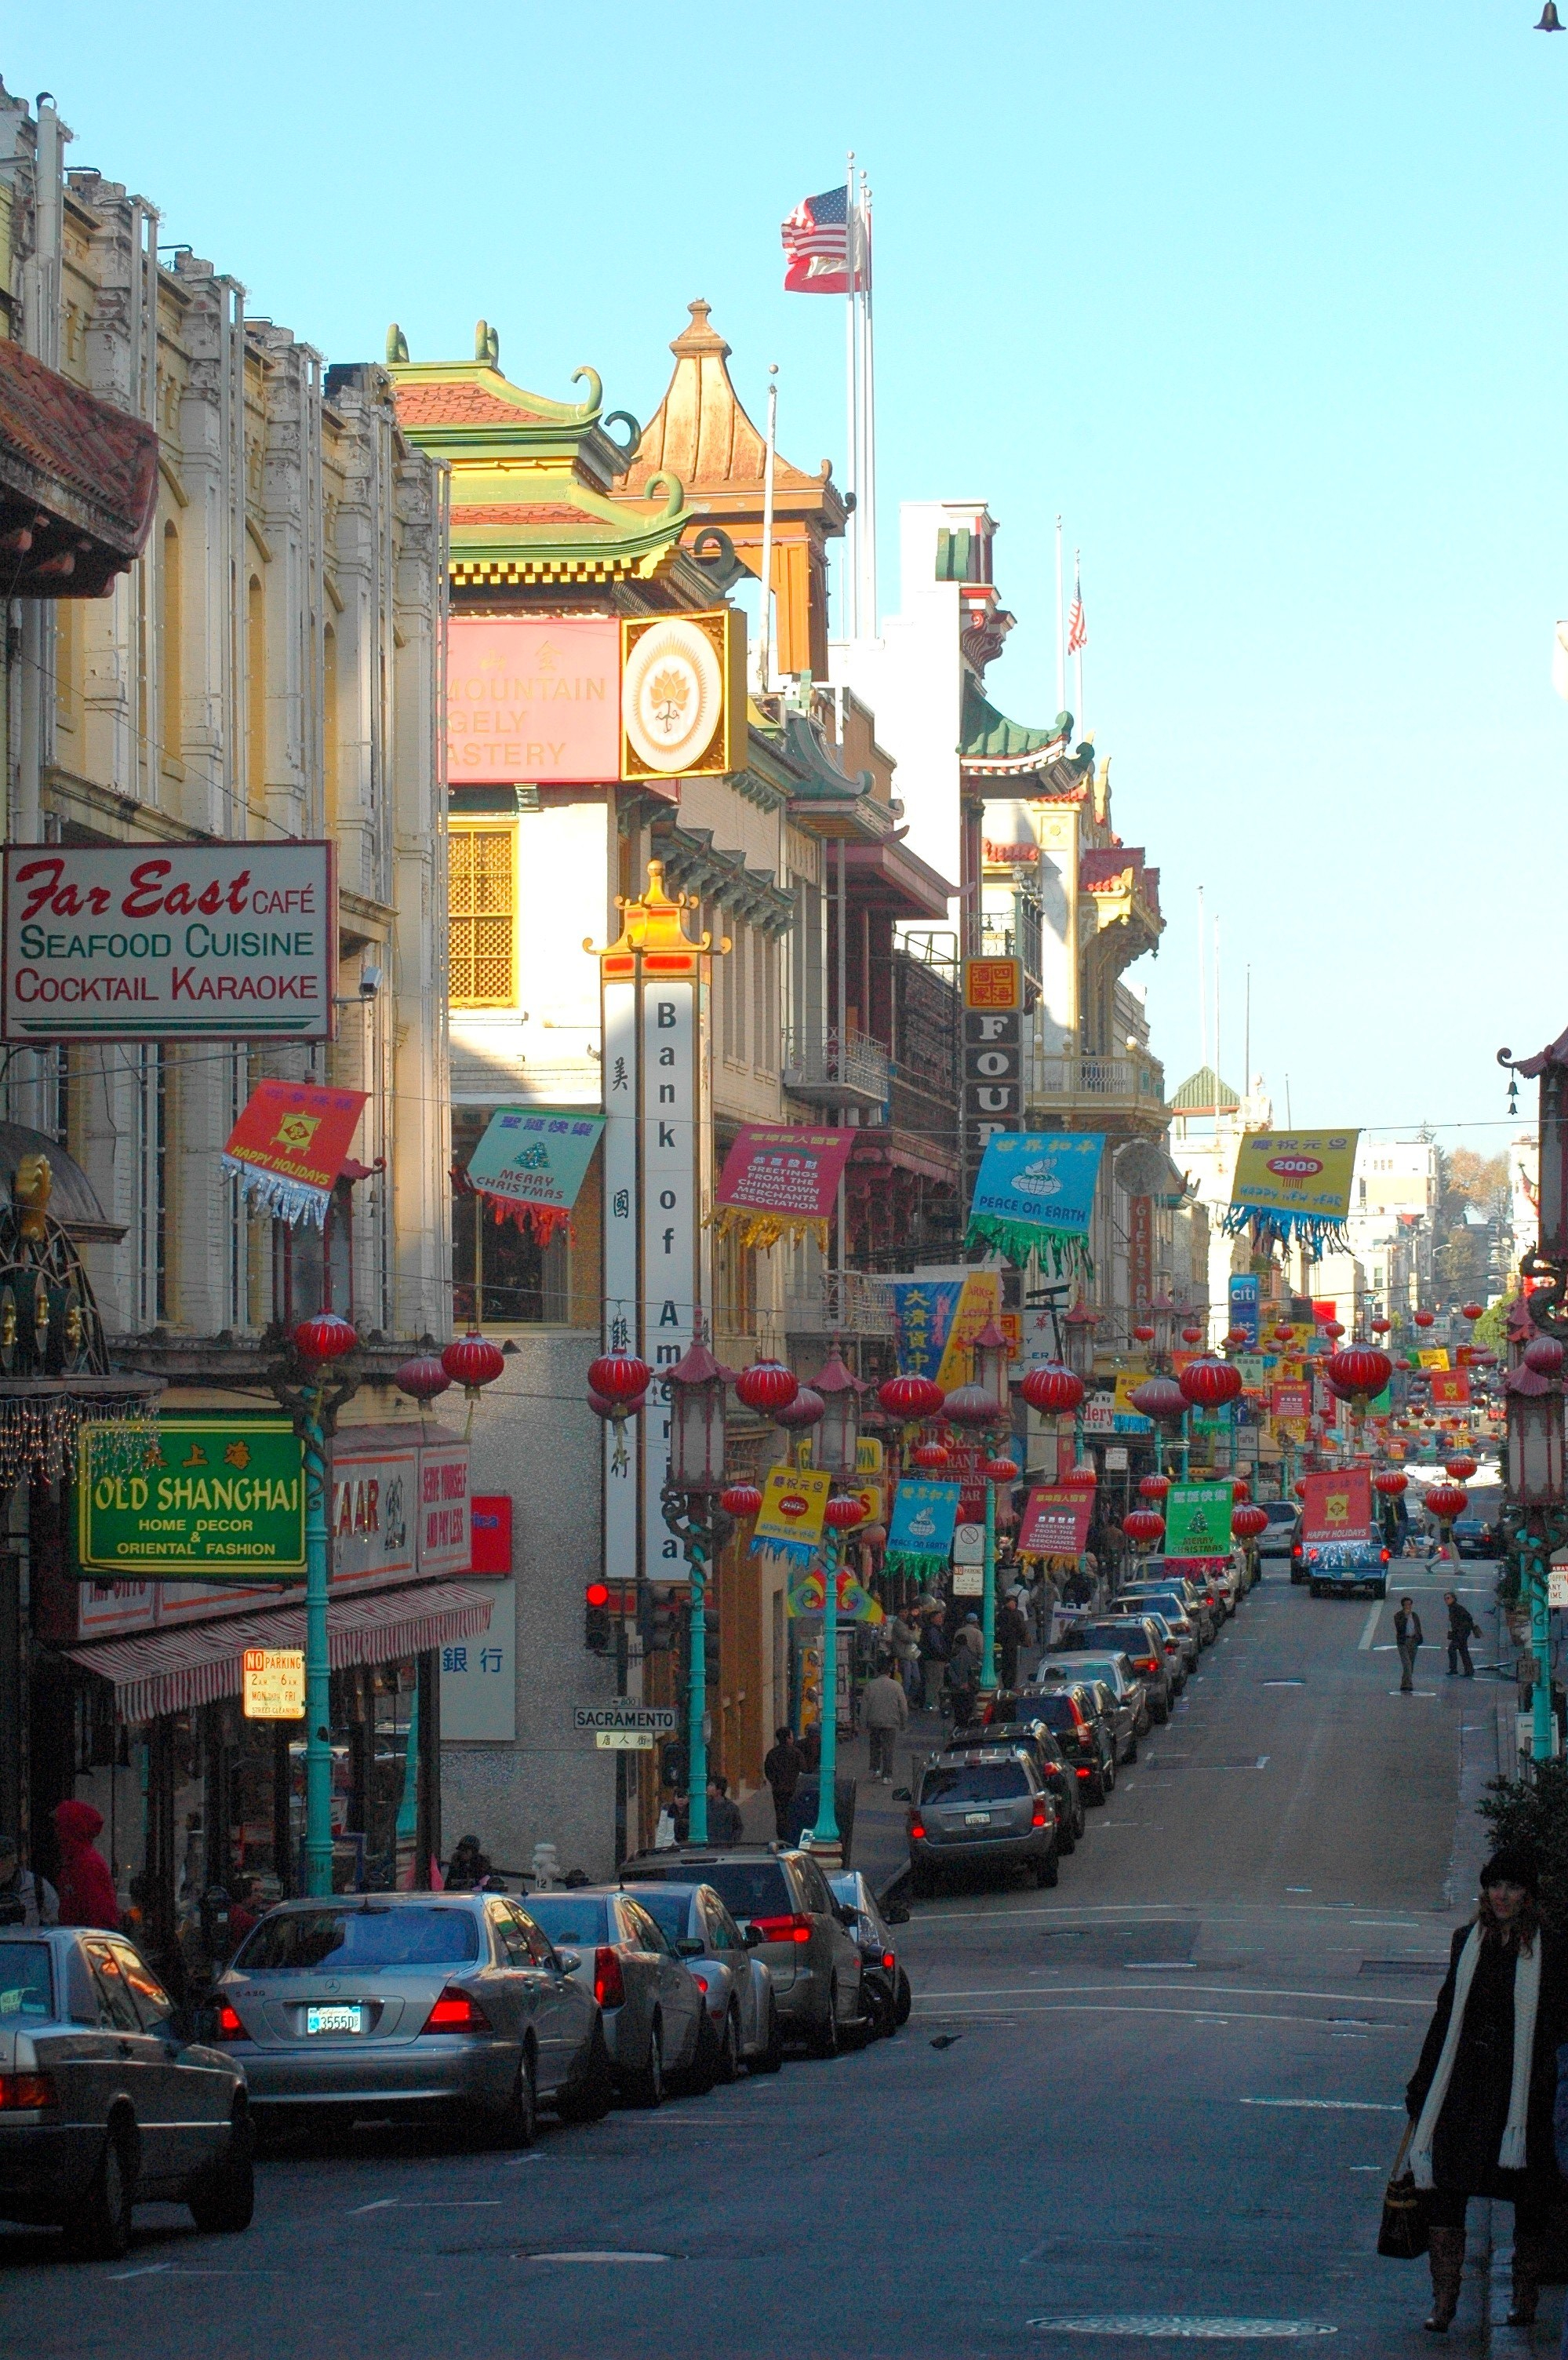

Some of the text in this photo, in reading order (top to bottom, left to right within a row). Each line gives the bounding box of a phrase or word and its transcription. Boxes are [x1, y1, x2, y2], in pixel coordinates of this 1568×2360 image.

[16, 858, 315, 921] Far East CAFÉ
[21, 923, 314, 960] SEAFOOD CUISINE
[15, 966, 318, 1003] COCKTAIL KARAOKE
[657, 1002, 677, 1148] Bank
[231, 1145, 330, 1185] HAPPY HOLIDAYS
[747, 1165, 820, 1178] GREETINGS
[1273, 1160, 1319, 1172] 2009
[499, 1169, 555, 1186] MERRY
[737, 1178, 820, 1194] CHINATOWN
[748, 1172, 815, 1185] FROM THE
[476, 1176, 564, 1200] CHRISTMAS
[737, 1185, 817, 1202] MERCHANTS
[1239, 1185, 1279, 1200] HAPPY
[730, 1193, 819, 1211] ASSOCIATION
[979, 1196, 1086, 1222] PEACE ON EARTH
[660, 1190, 676, 1254] of
[1231, 1286, 1255, 1301] citi
[657, 1300, 682, 1558] Amra
[95, 1477, 298, 1512] OLD SHANGHAI
[139, 1519, 253, 1531] HOME DECOR
[1306, 1528, 1367, 1539] HAPPY HOLIDAYS
[190, 1531, 201, 1543] &
[117, 1542, 275, 1555] ORIENTAL FASHION
[247, 1652, 301, 1670] NO PARKING
[442, 1647, 504, 1673] 銀行
[252, 1673, 257, 1685] 2
[281, 1673, 287, 1685] 6
[577, 1711, 673, 1727] SACRAMENTO
